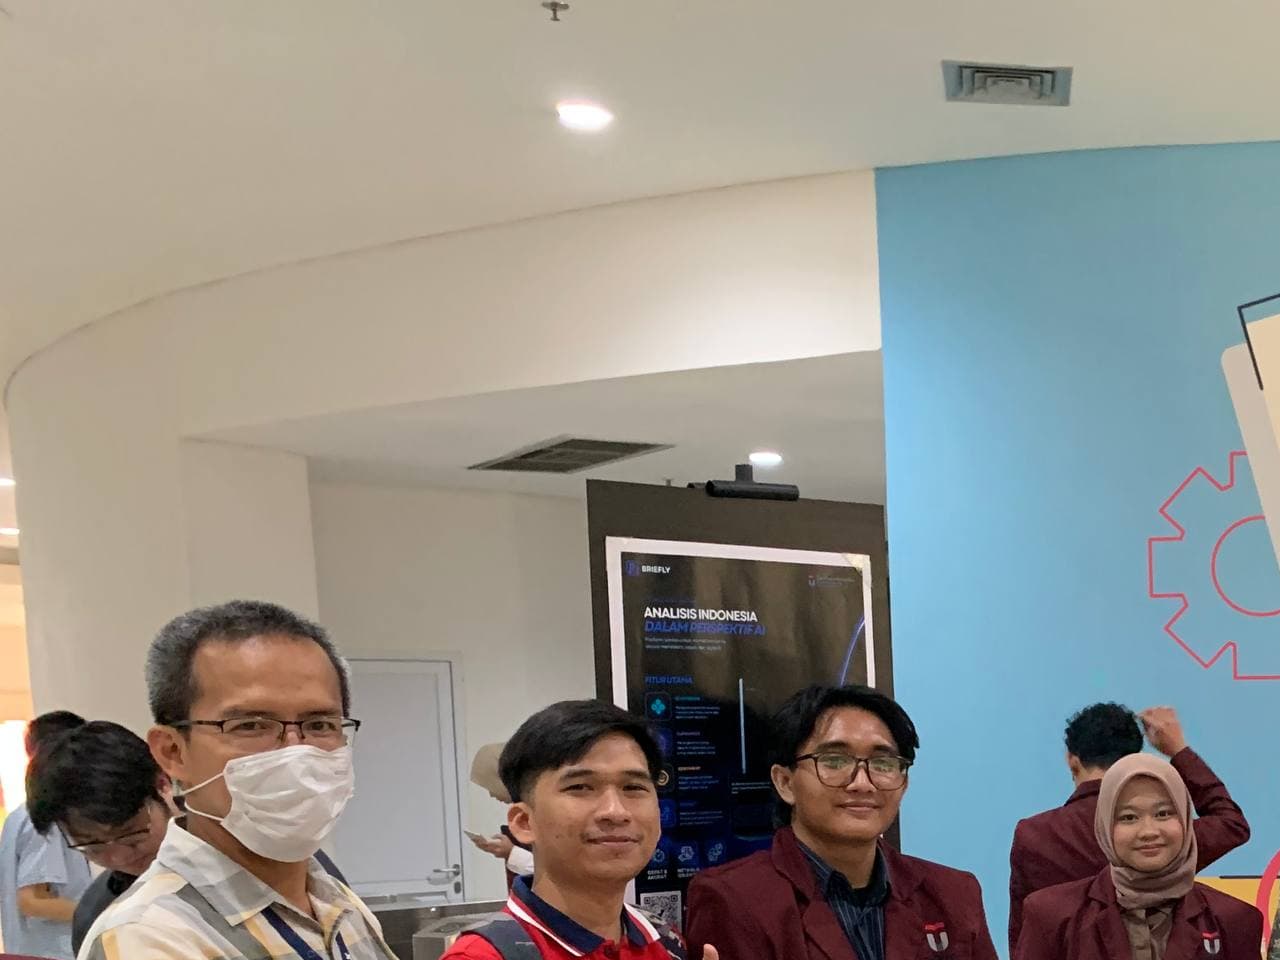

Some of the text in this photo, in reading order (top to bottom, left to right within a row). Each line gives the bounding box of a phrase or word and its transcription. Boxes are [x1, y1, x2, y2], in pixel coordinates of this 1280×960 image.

[641, 565, 671, 574] BRIEFLY
[644, 606, 758, 622] ANALISIS INDONESIA
[644, 621, 689, 633] DALAM
[689, 622, 754, 635] PERSPEKTIF
